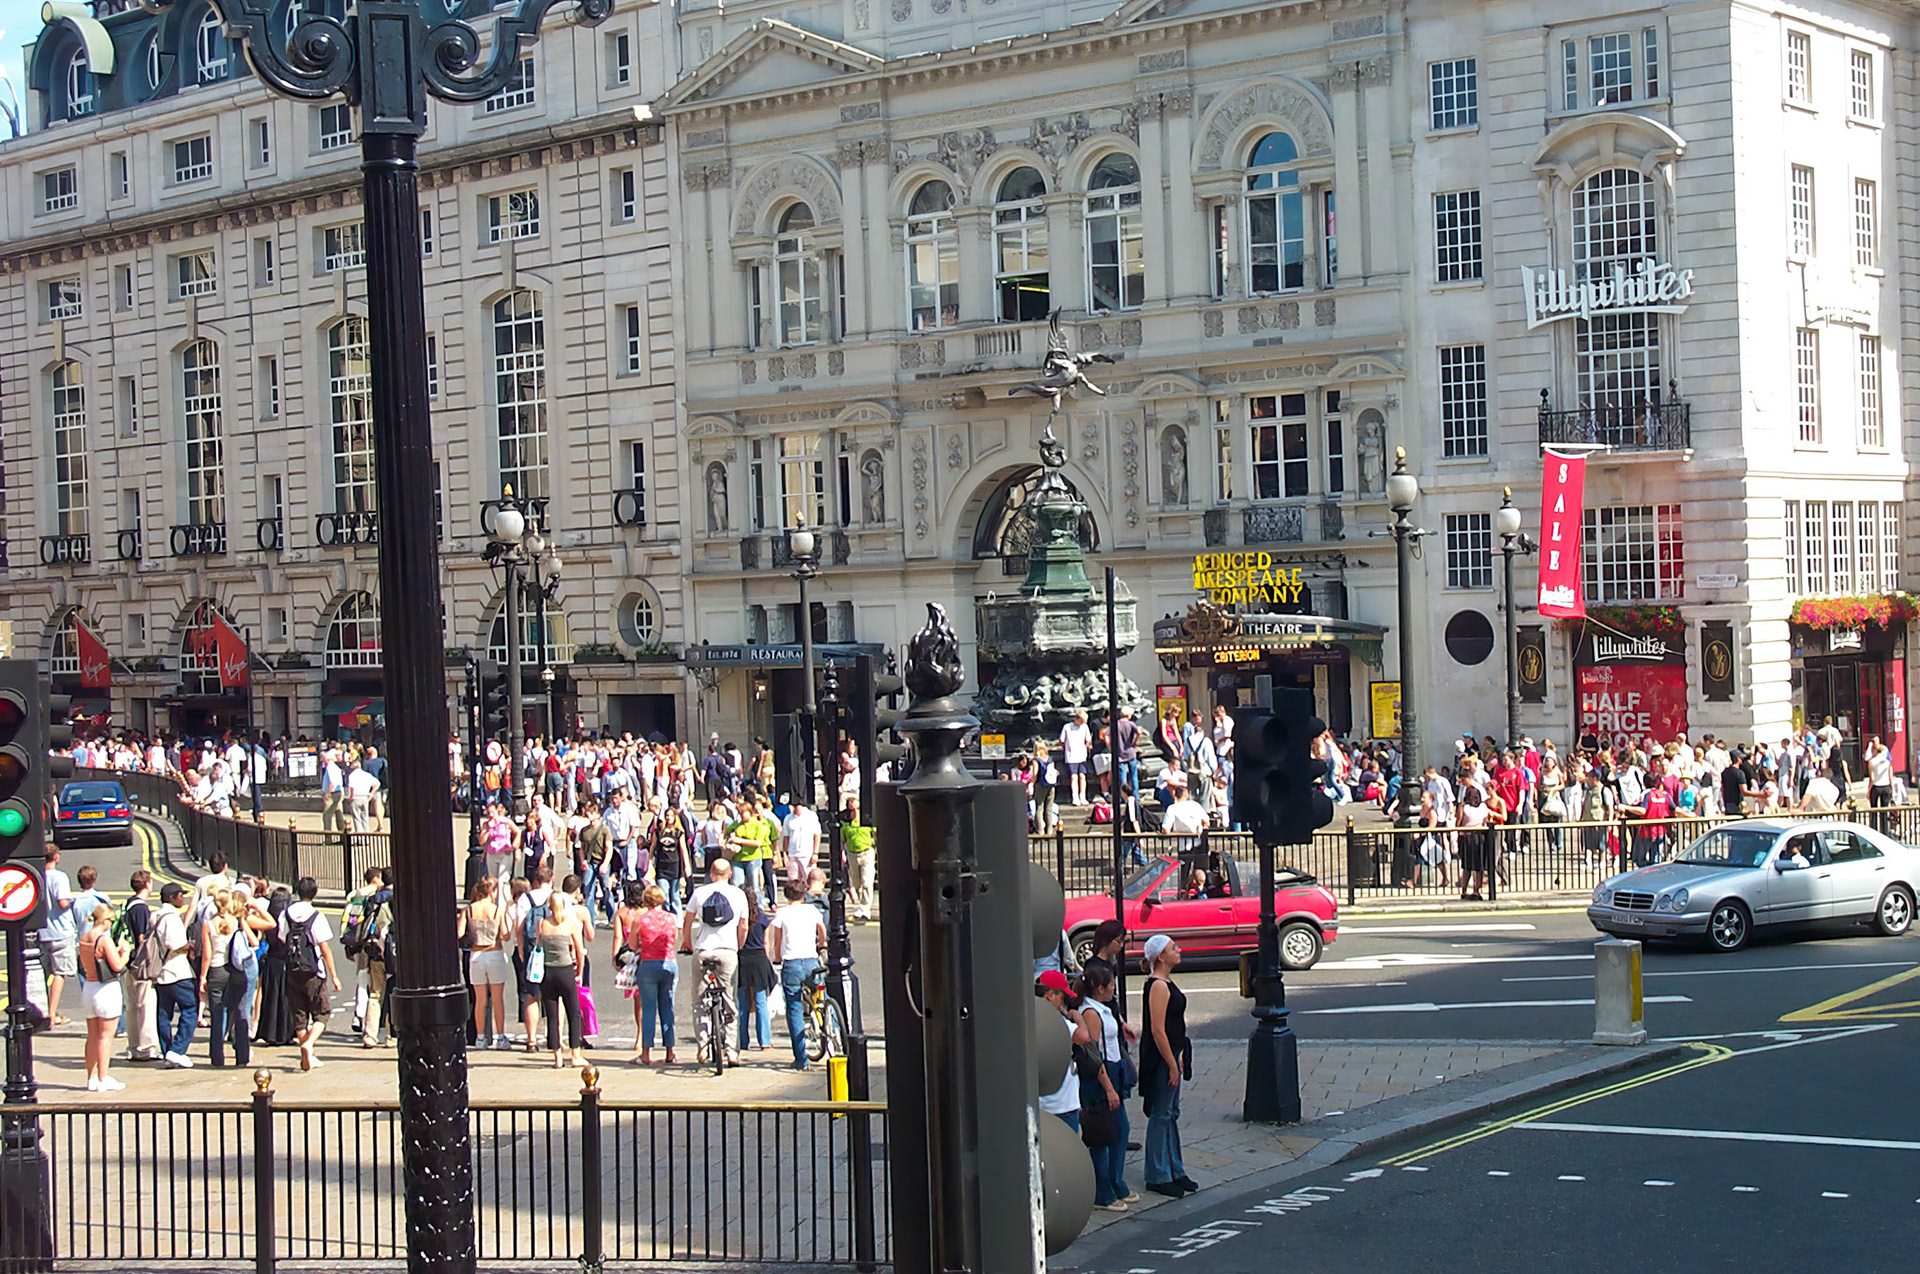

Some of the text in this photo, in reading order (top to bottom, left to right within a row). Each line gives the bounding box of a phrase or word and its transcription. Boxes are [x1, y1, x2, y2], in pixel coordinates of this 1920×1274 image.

[1521, 258, 1695, 331] Lillywhites
[1549, 463, 1568, 570] SALE
[1211, 585, 1303, 605] COMPANY
[1248, 623, 1303, 635] THEATRE
[1591, 633, 1667, 662] Lillywhites
[1582, 692, 1641, 711] HALF
[1583, 712, 1651, 731] PRICE
[1245, 1186, 1346, 1215] LOOK
[1139, 1219, 1263, 1258] LEFT
